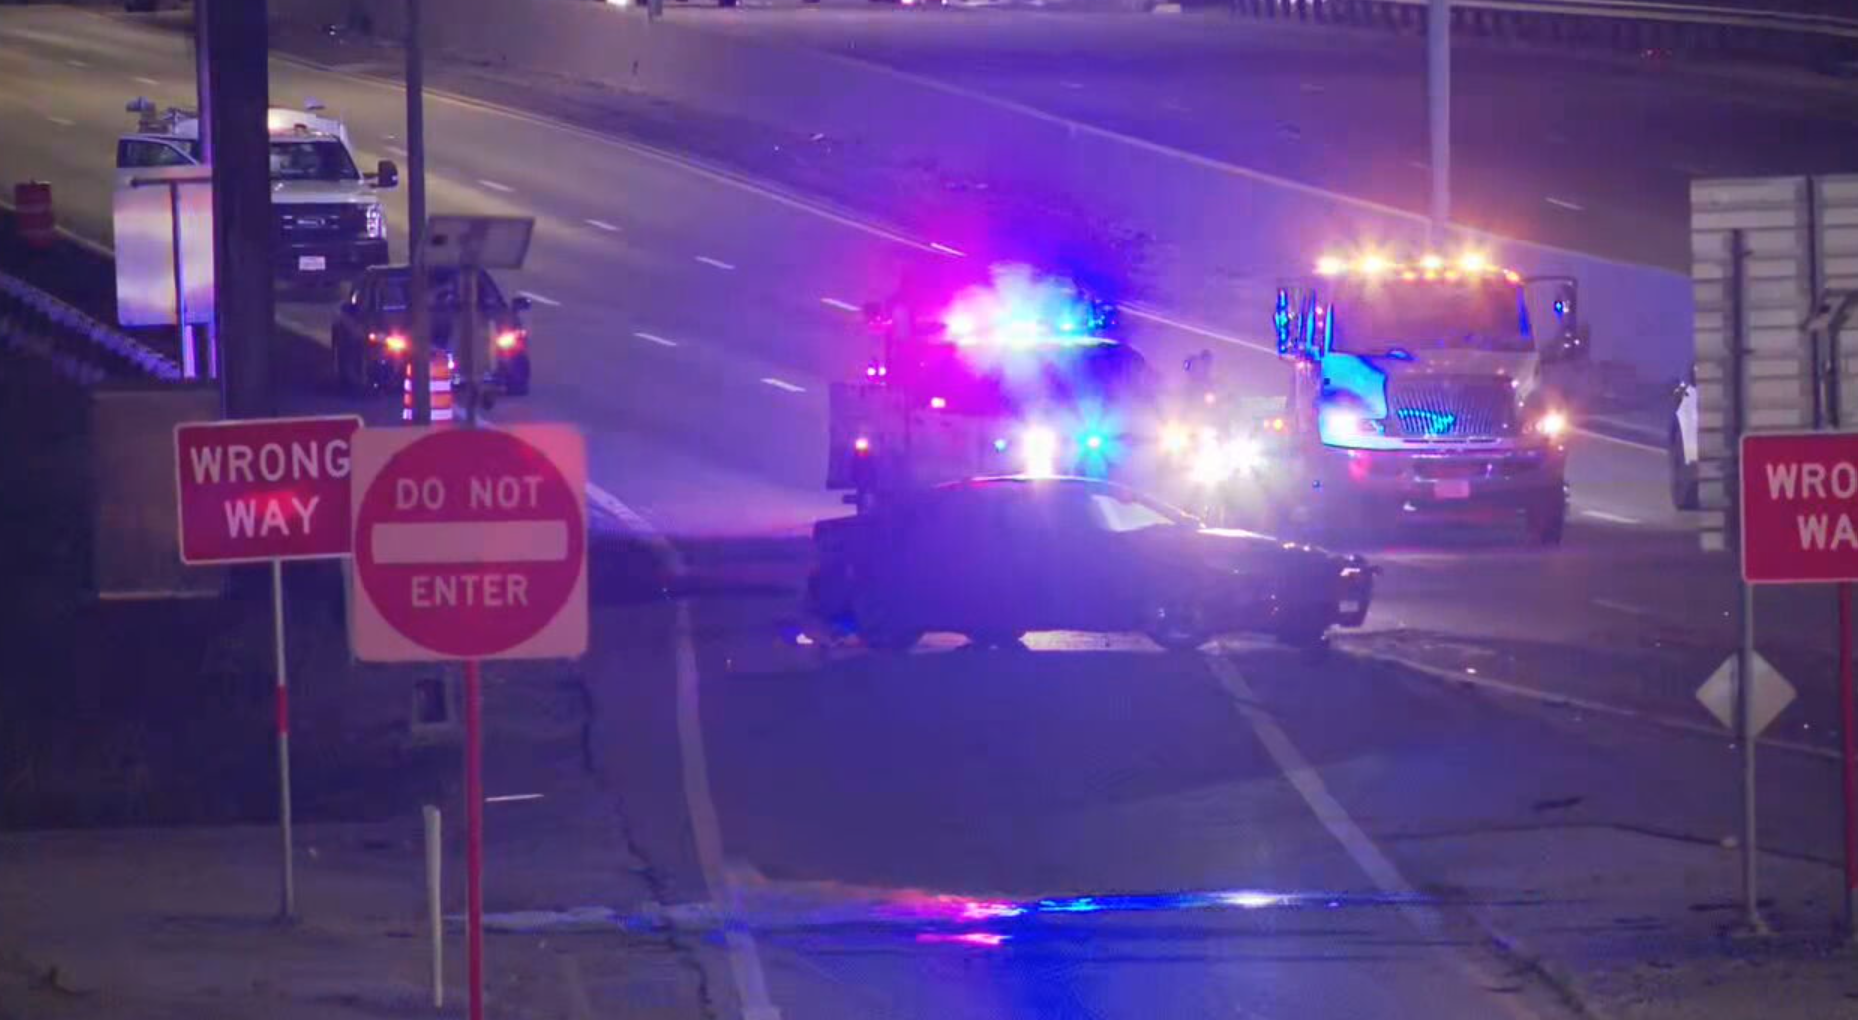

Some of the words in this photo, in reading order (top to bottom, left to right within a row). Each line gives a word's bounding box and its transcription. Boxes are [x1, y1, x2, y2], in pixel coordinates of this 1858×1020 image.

[190, 439, 351, 485] WRONG
[396, 477, 445, 511] DO
[469, 475, 544, 510] NOT
[224, 495, 320, 539] WAY
[411, 573, 529, 608] ENTER
